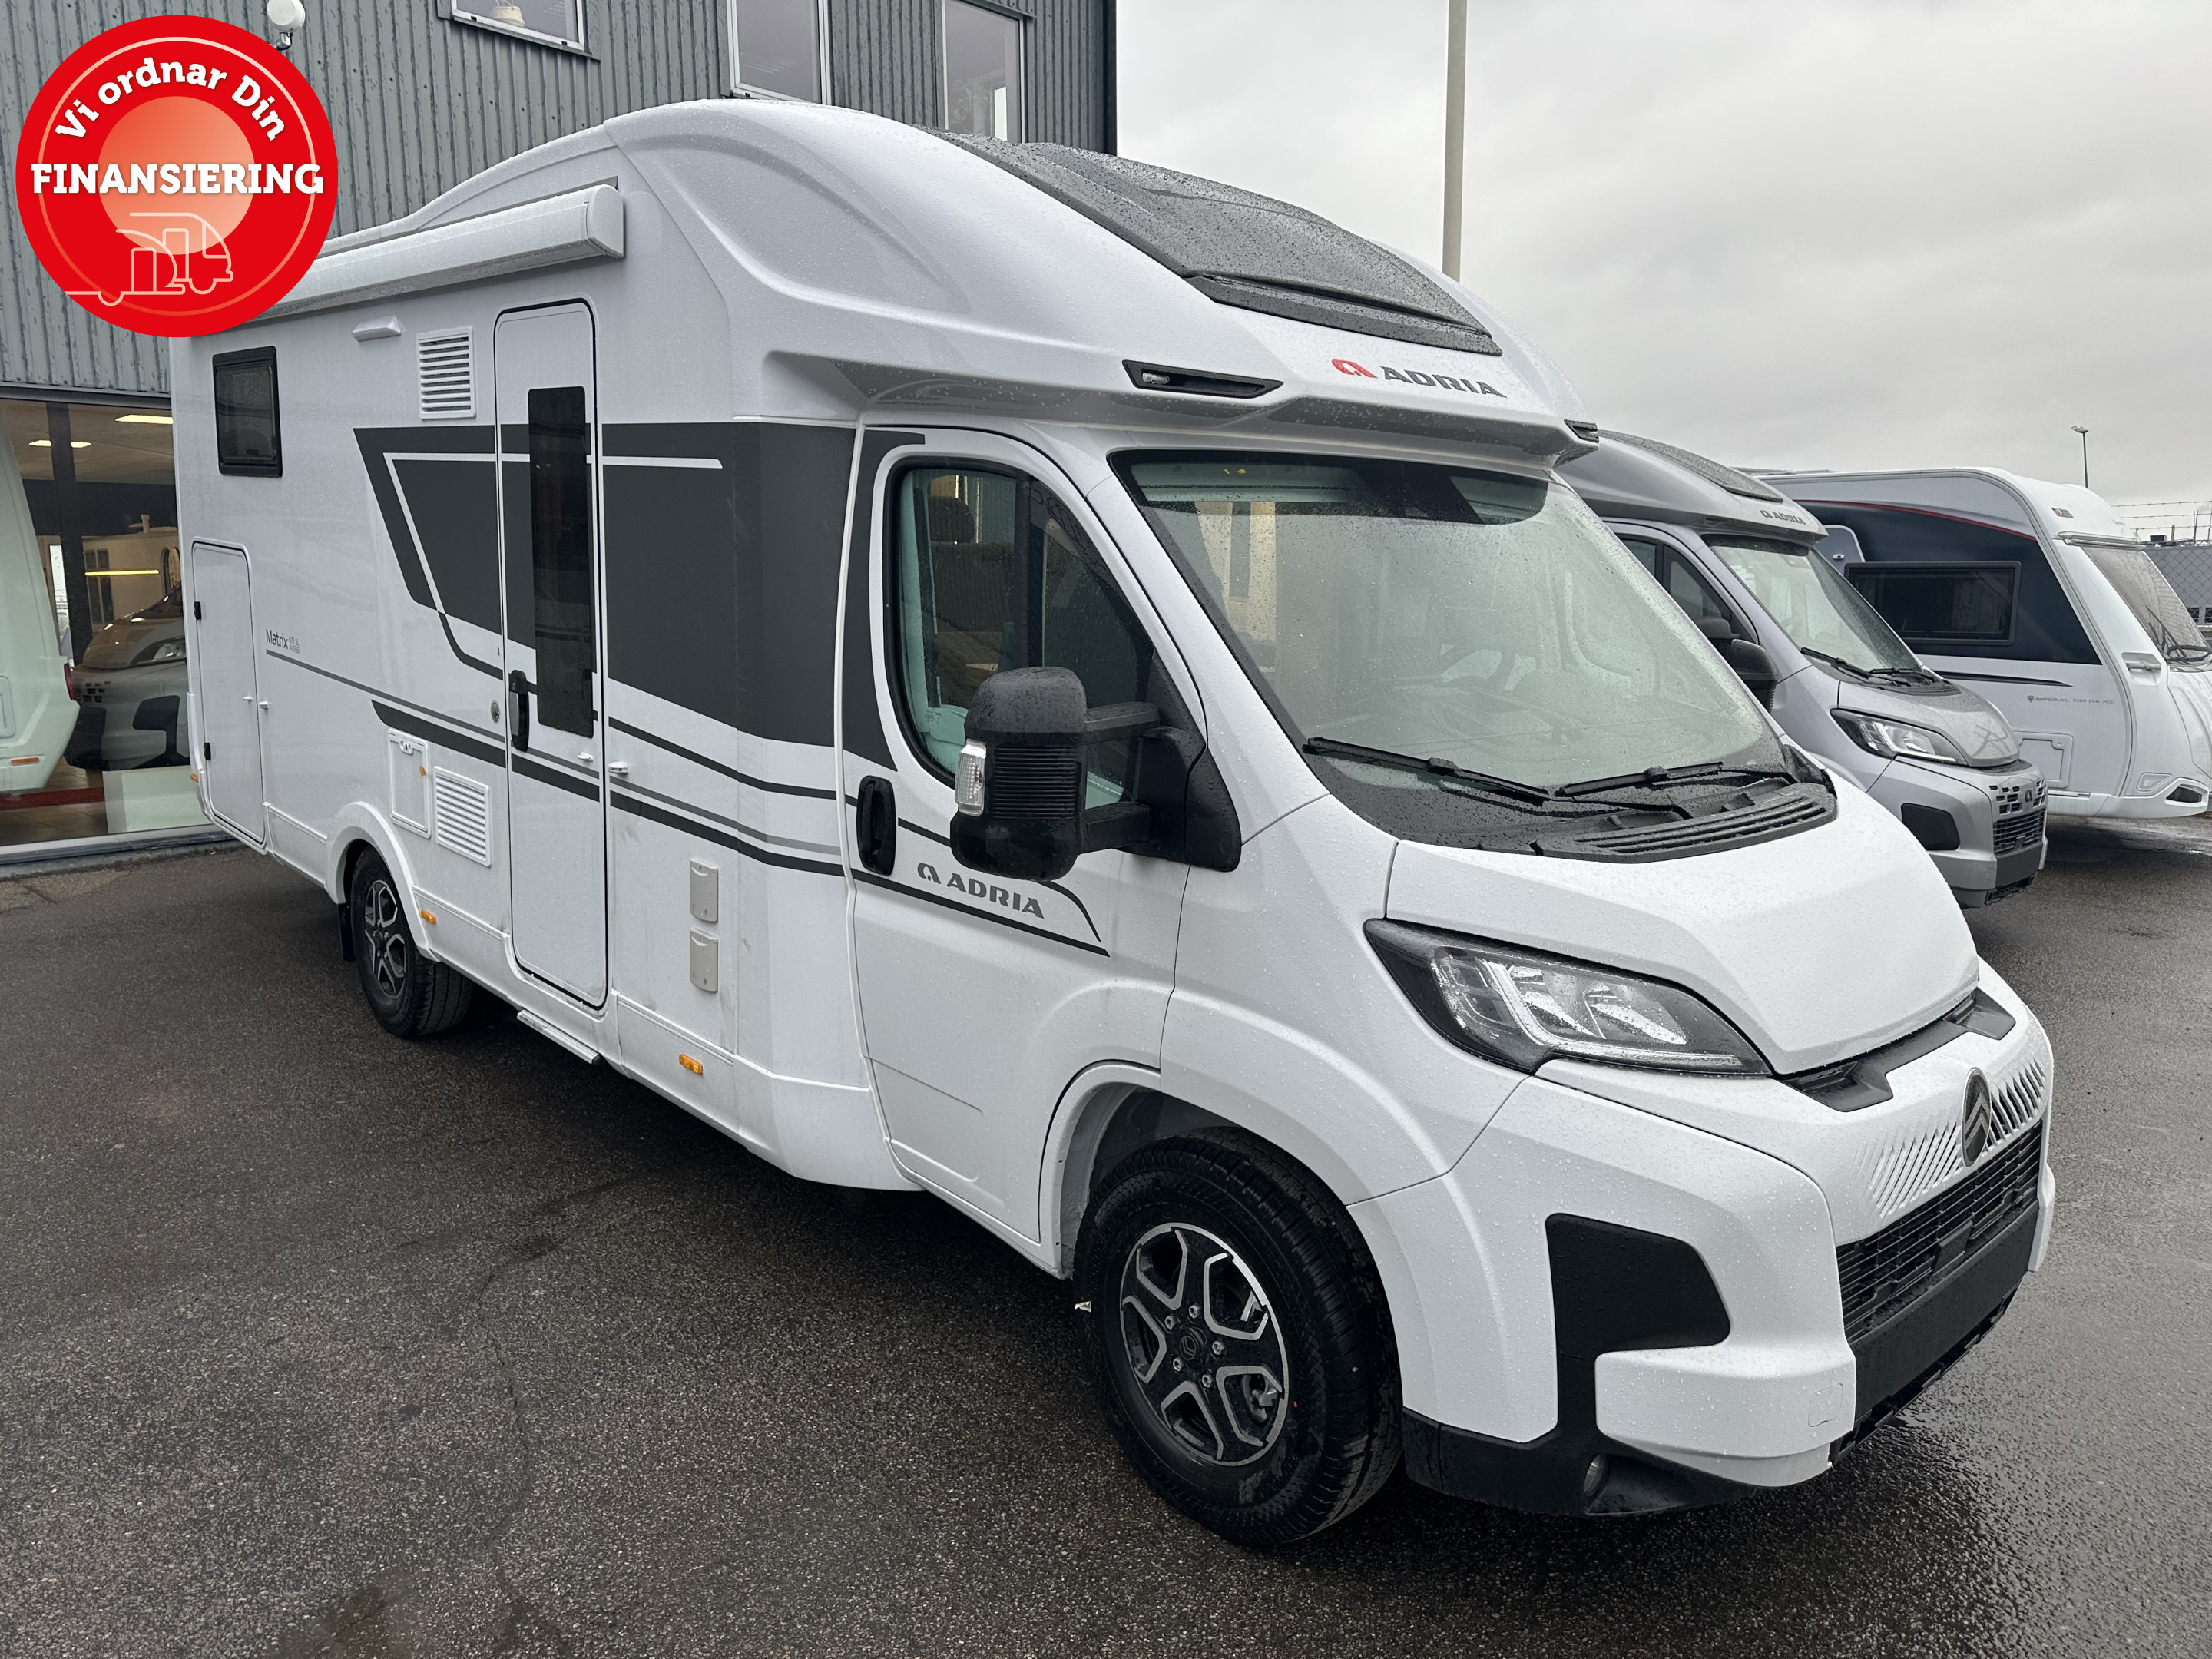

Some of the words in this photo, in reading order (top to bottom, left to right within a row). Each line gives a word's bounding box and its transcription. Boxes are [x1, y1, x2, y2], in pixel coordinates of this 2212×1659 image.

[1380, 366, 1507, 398] ADRIA
[1772, 512, 1806, 525] ADRIA
[266, 628, 288, 650] Matrix
[946, 872, 1045, 919] ADRIA
